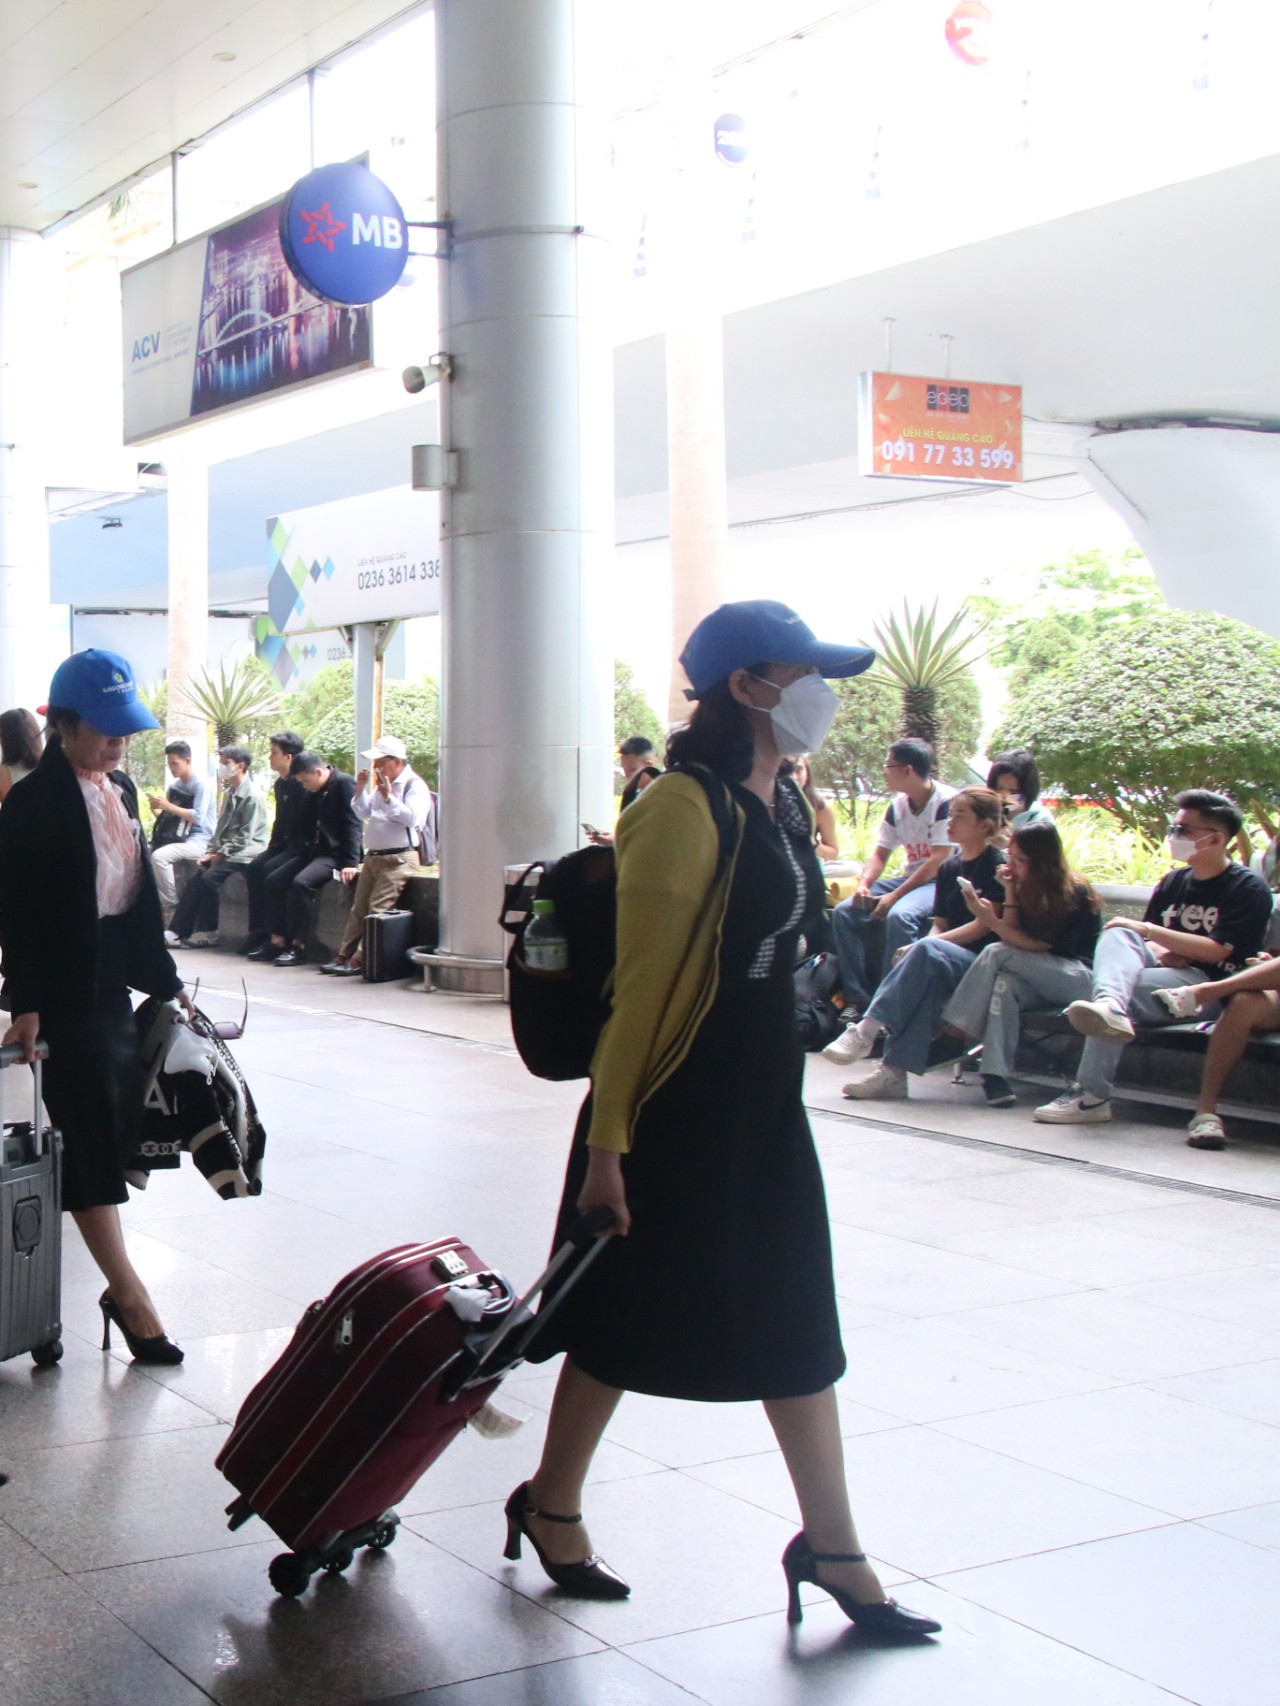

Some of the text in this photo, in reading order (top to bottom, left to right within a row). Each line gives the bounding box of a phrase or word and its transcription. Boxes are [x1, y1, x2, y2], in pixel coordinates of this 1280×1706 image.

[352, 212, 403, 249] MB
[131, 331, 161, 363] ACV
[881, 440, 1014, 469] 091 77 33 599
[357, 570, 384, 590] 0236
[388, 563, 416, 586] 3614
